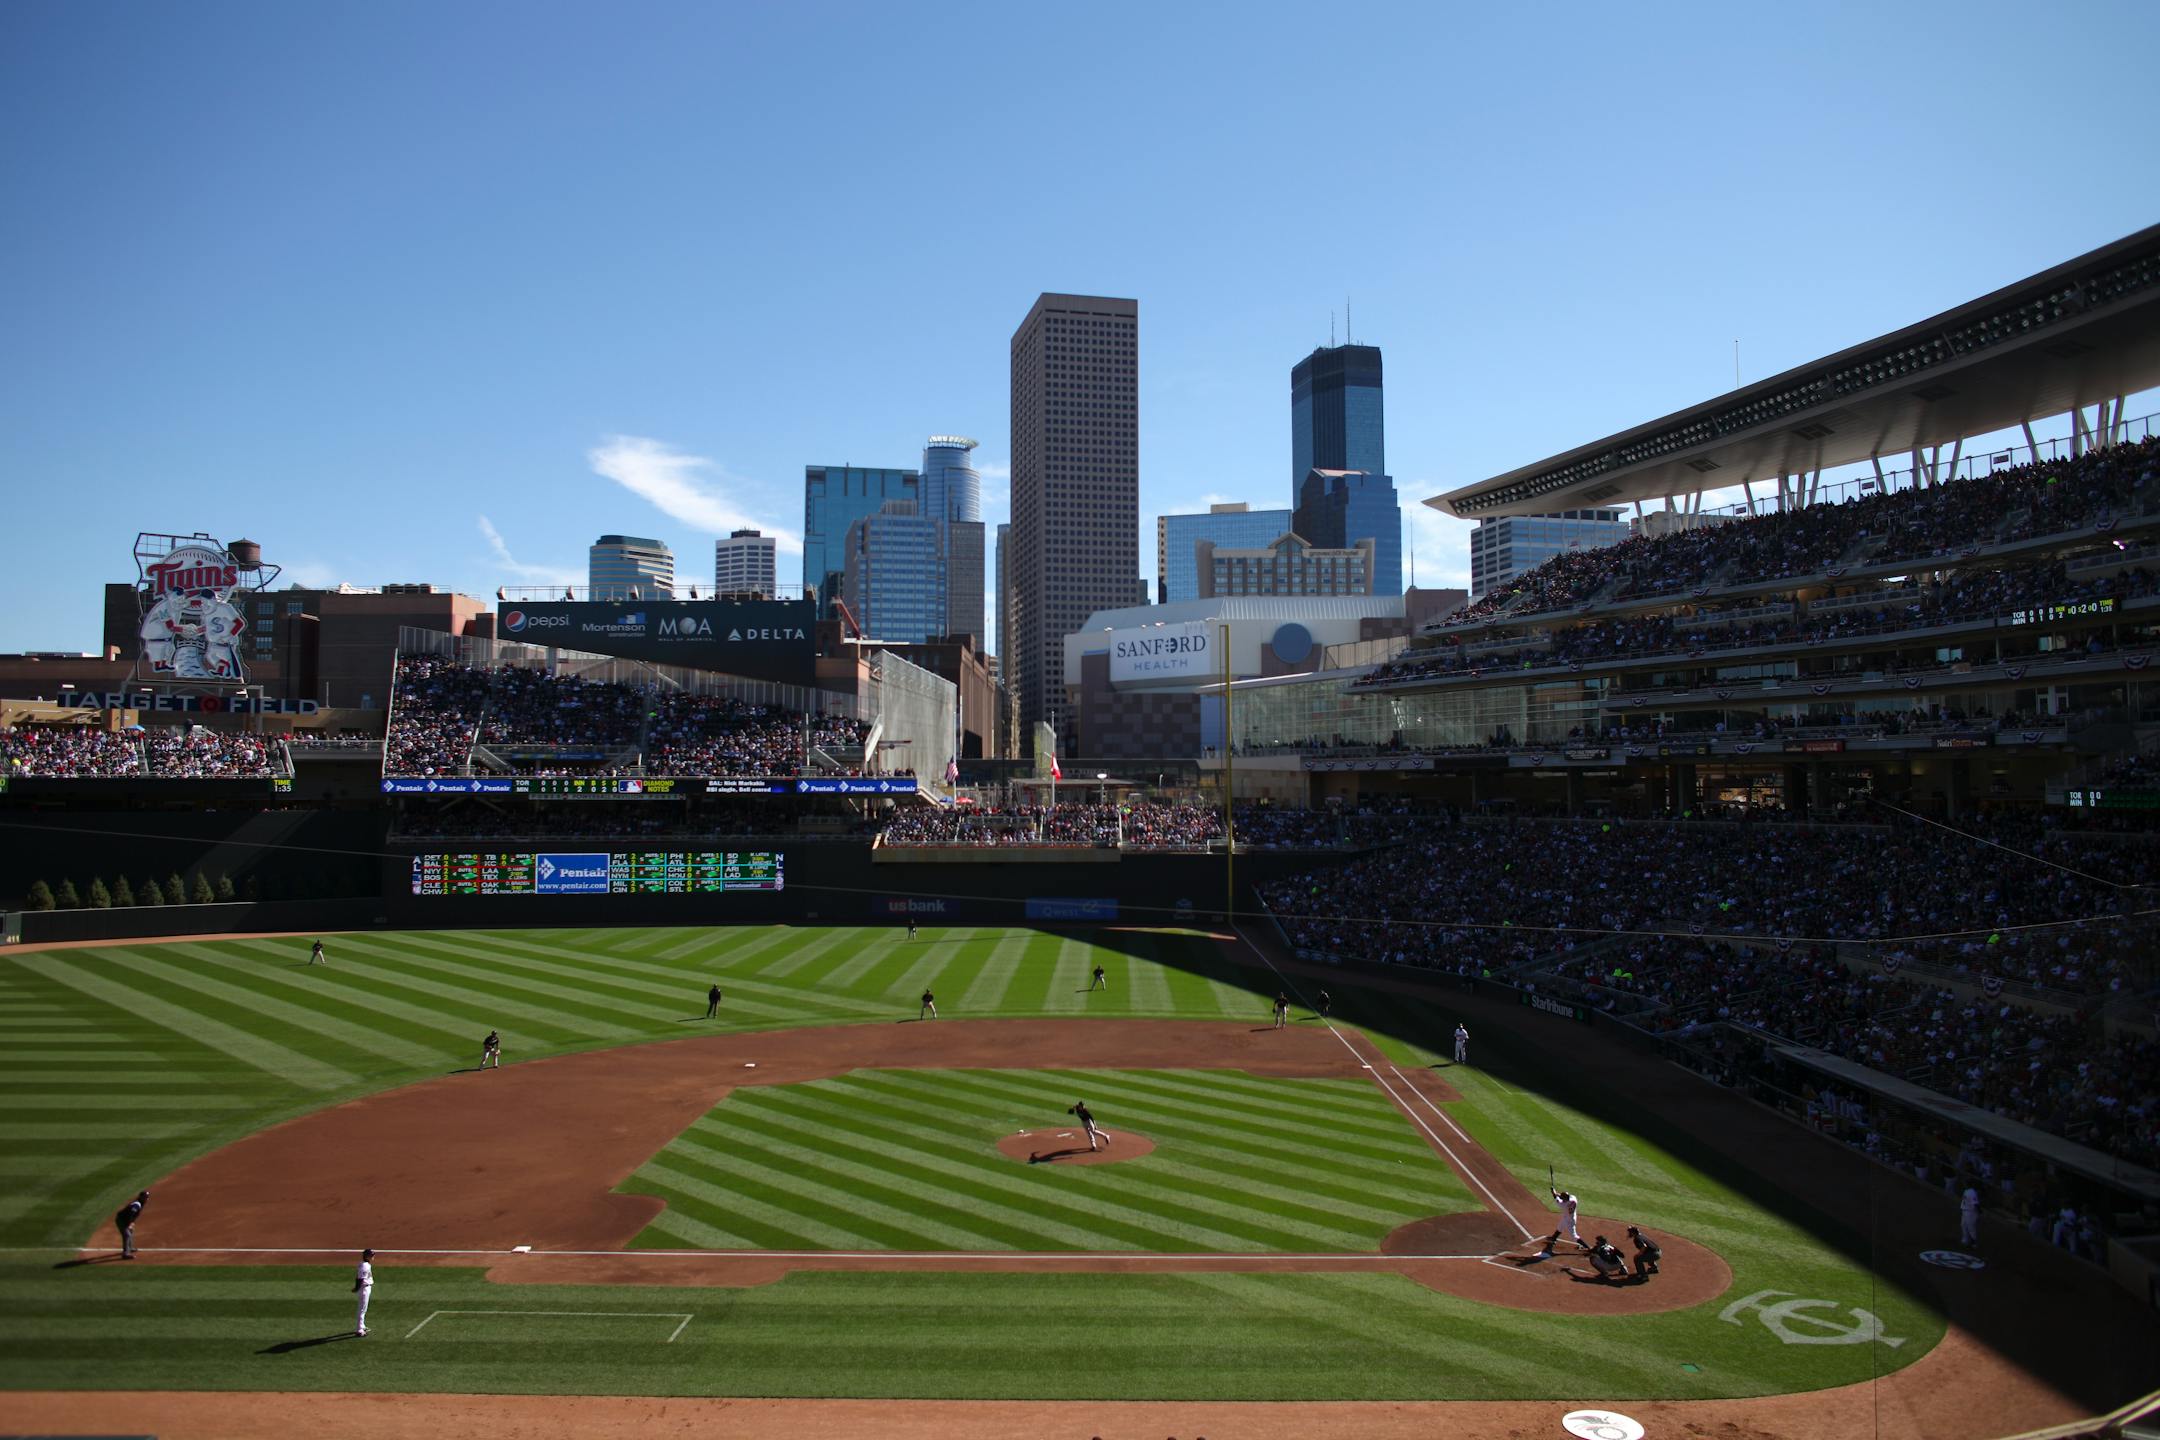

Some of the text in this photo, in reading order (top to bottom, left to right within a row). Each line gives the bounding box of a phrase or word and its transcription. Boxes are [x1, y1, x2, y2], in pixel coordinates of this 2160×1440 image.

[147, 560, 238, 595] Twins
[528, 615, 569, 628] pepsi
[747, 628, 805, 640] DELTA
[1117, 635, 1206, 658] SANFORD
[1134, 660, 1188, 670] HEALTH
[58, 691, 318, 715] TARGET FIELD
[560, 868, 606, 877] Pentair
[539, 882, 606, 891] www.pentair.com
[1532, 995, 1573, 1017] StarTribune
